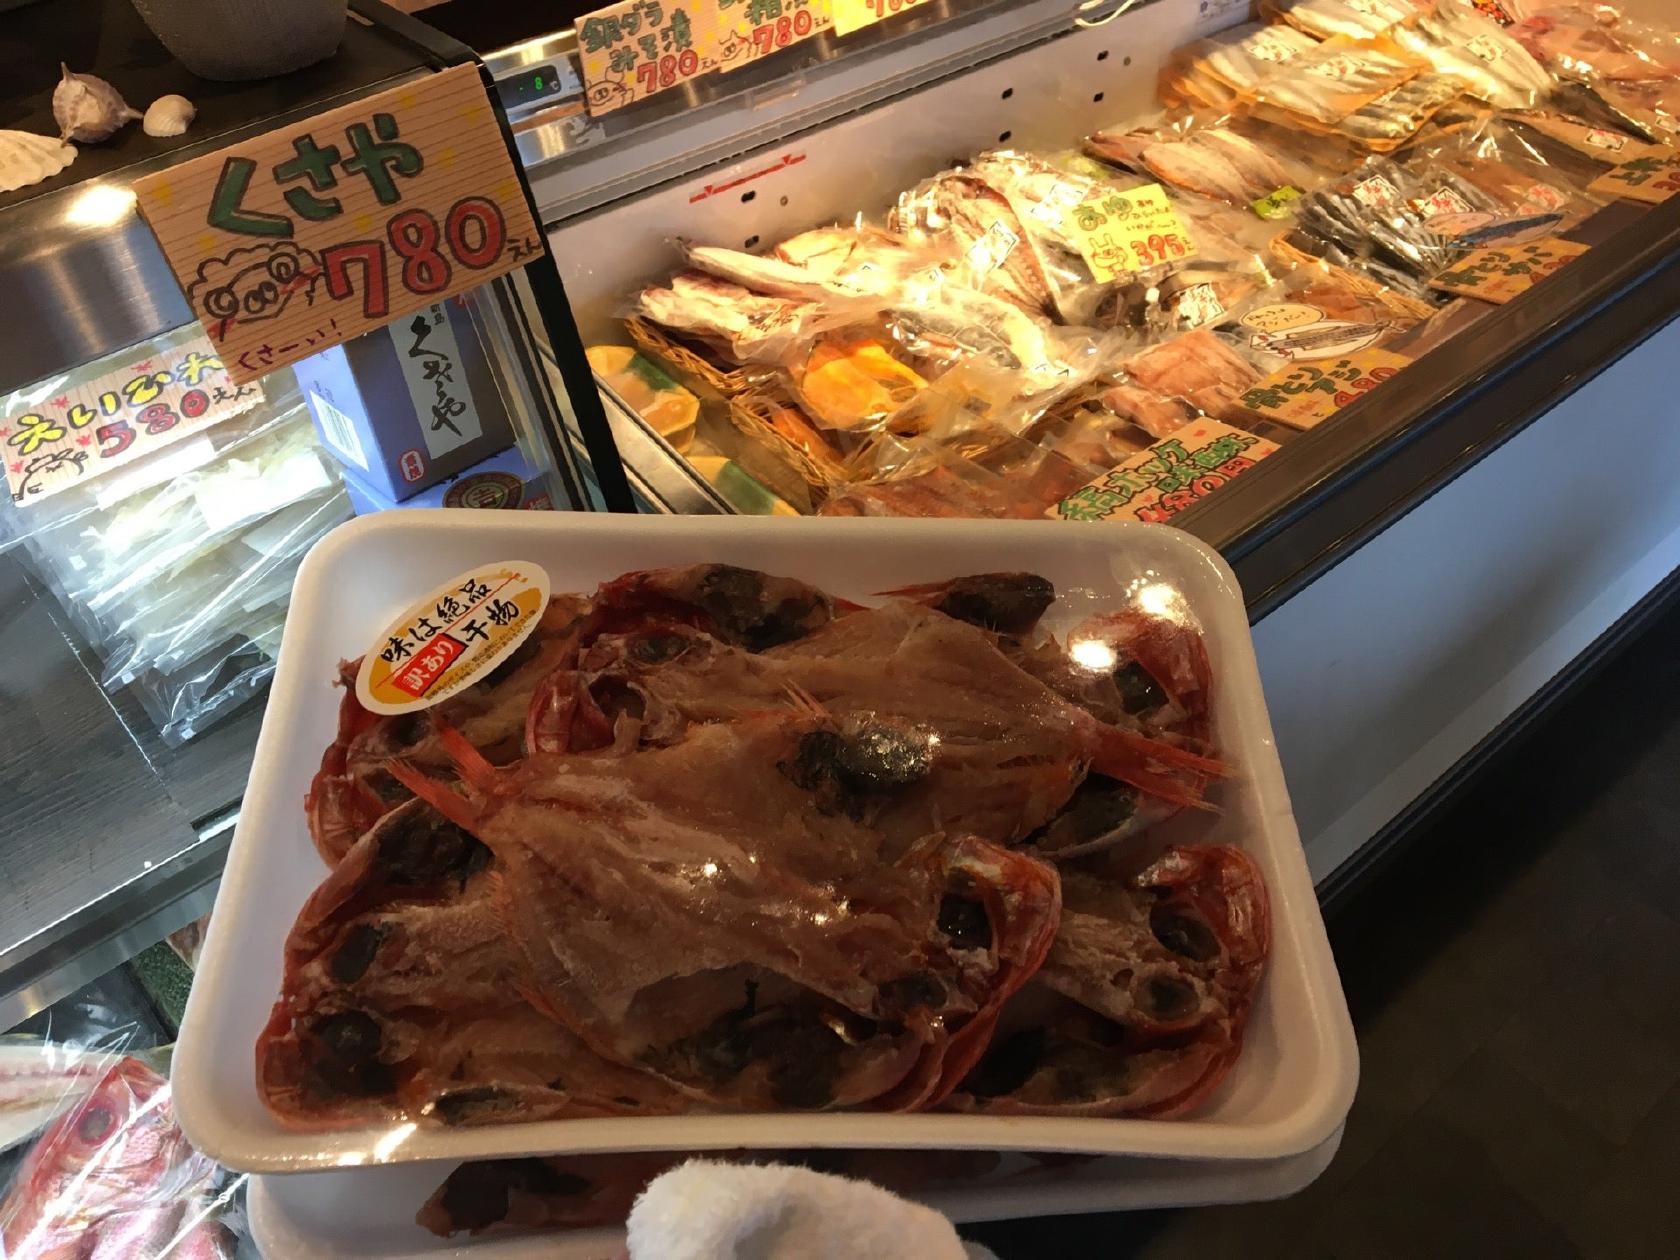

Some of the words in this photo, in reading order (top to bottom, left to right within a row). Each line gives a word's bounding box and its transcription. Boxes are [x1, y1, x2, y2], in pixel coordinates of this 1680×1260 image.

[206, 112, 425, 239] くさや
[1130, 234, 1185, 267] 395
[381, 578, 492, 663] 味は絶品
[402, 640, 454, 691] 訳あり
[461, 598, 520, 642] 干物
